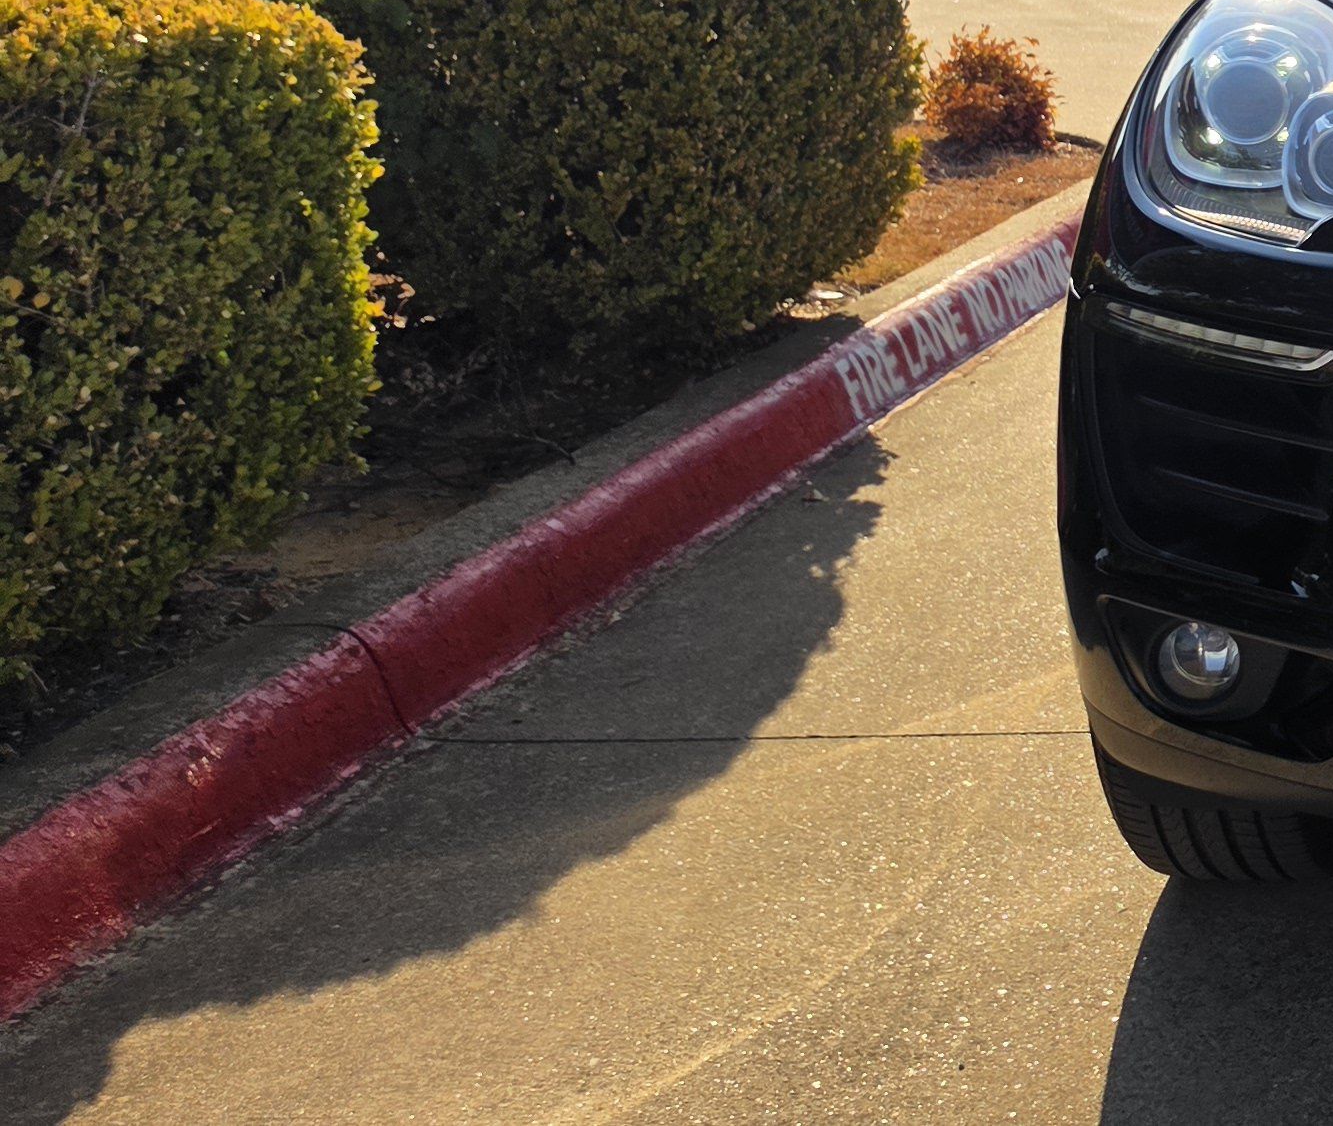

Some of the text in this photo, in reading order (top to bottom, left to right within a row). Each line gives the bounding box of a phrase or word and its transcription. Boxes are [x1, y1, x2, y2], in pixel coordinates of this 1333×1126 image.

[835, 238, 1071, 421] FIRE LANE NO PARKING
